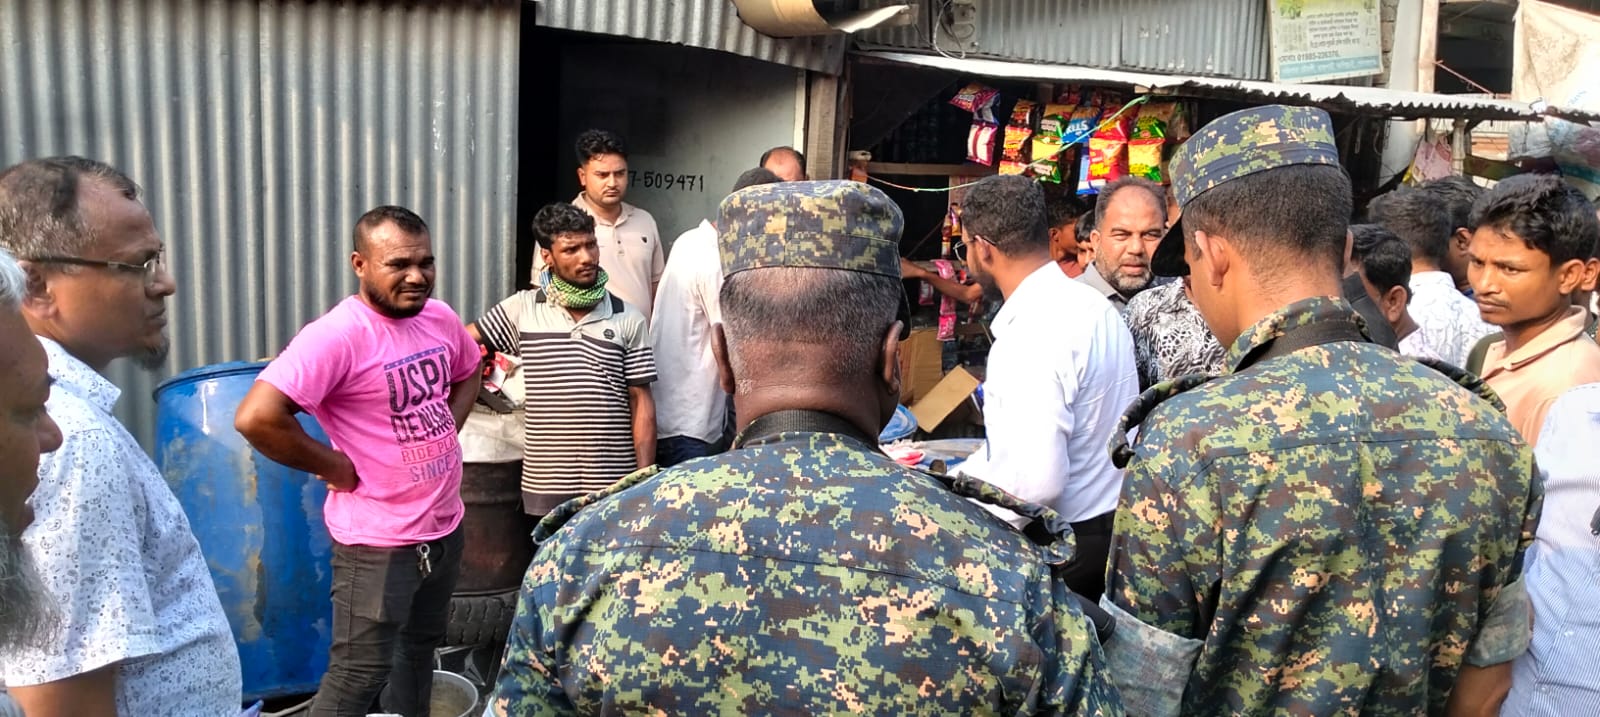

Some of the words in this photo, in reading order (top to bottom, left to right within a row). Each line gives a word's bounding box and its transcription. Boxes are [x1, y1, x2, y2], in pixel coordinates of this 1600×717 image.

[385, 353, 452, 413] USPA
[401, 447, 434, 463] RIDE
[410, 454, 451, 483] SINCE
